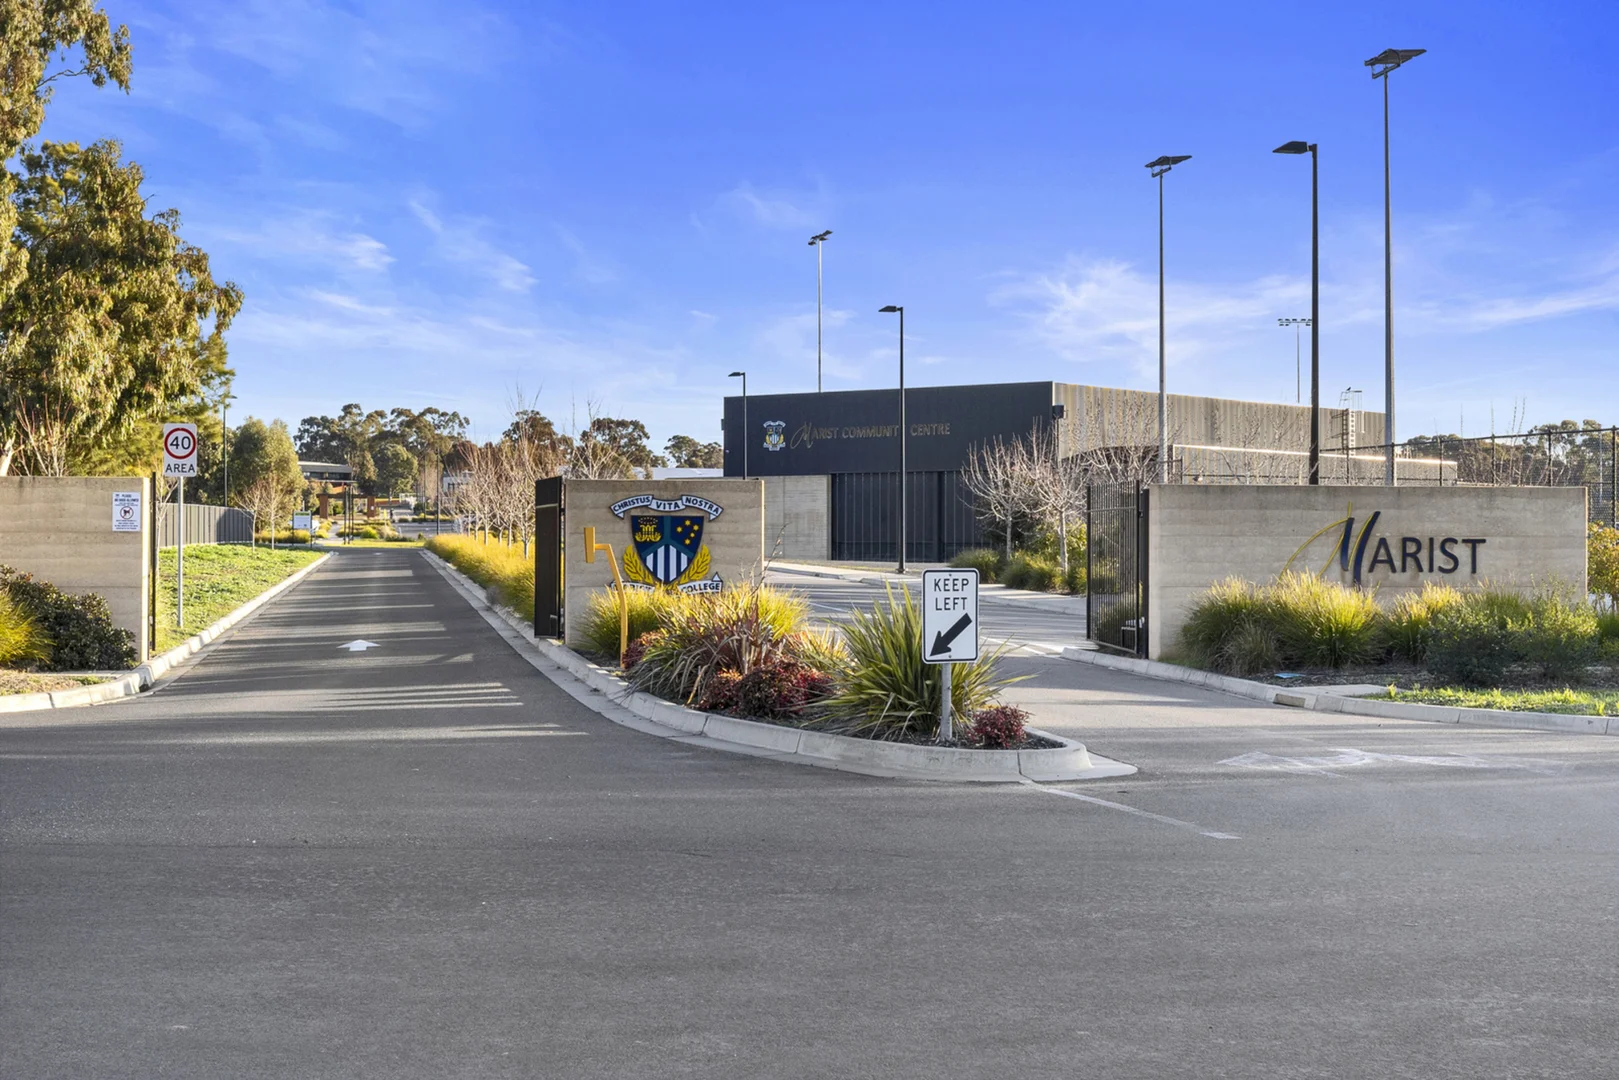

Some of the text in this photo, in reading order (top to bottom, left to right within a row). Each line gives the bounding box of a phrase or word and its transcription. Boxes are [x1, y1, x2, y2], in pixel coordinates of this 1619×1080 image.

[842, 425, 899, 438] COMMUNIT
[910, 423, 951, 436] CENTRE
[169, 435, 192, 450] 40
[165, 463, 196, 473] AREA
[613, 497, 719, 514] CHRISTUS VITA NOSTRA
[1280, 501, 1486, 591] MARIST
[933, 578, 970, 592] KEEP
[935, 597, 968, 611] LEFT
